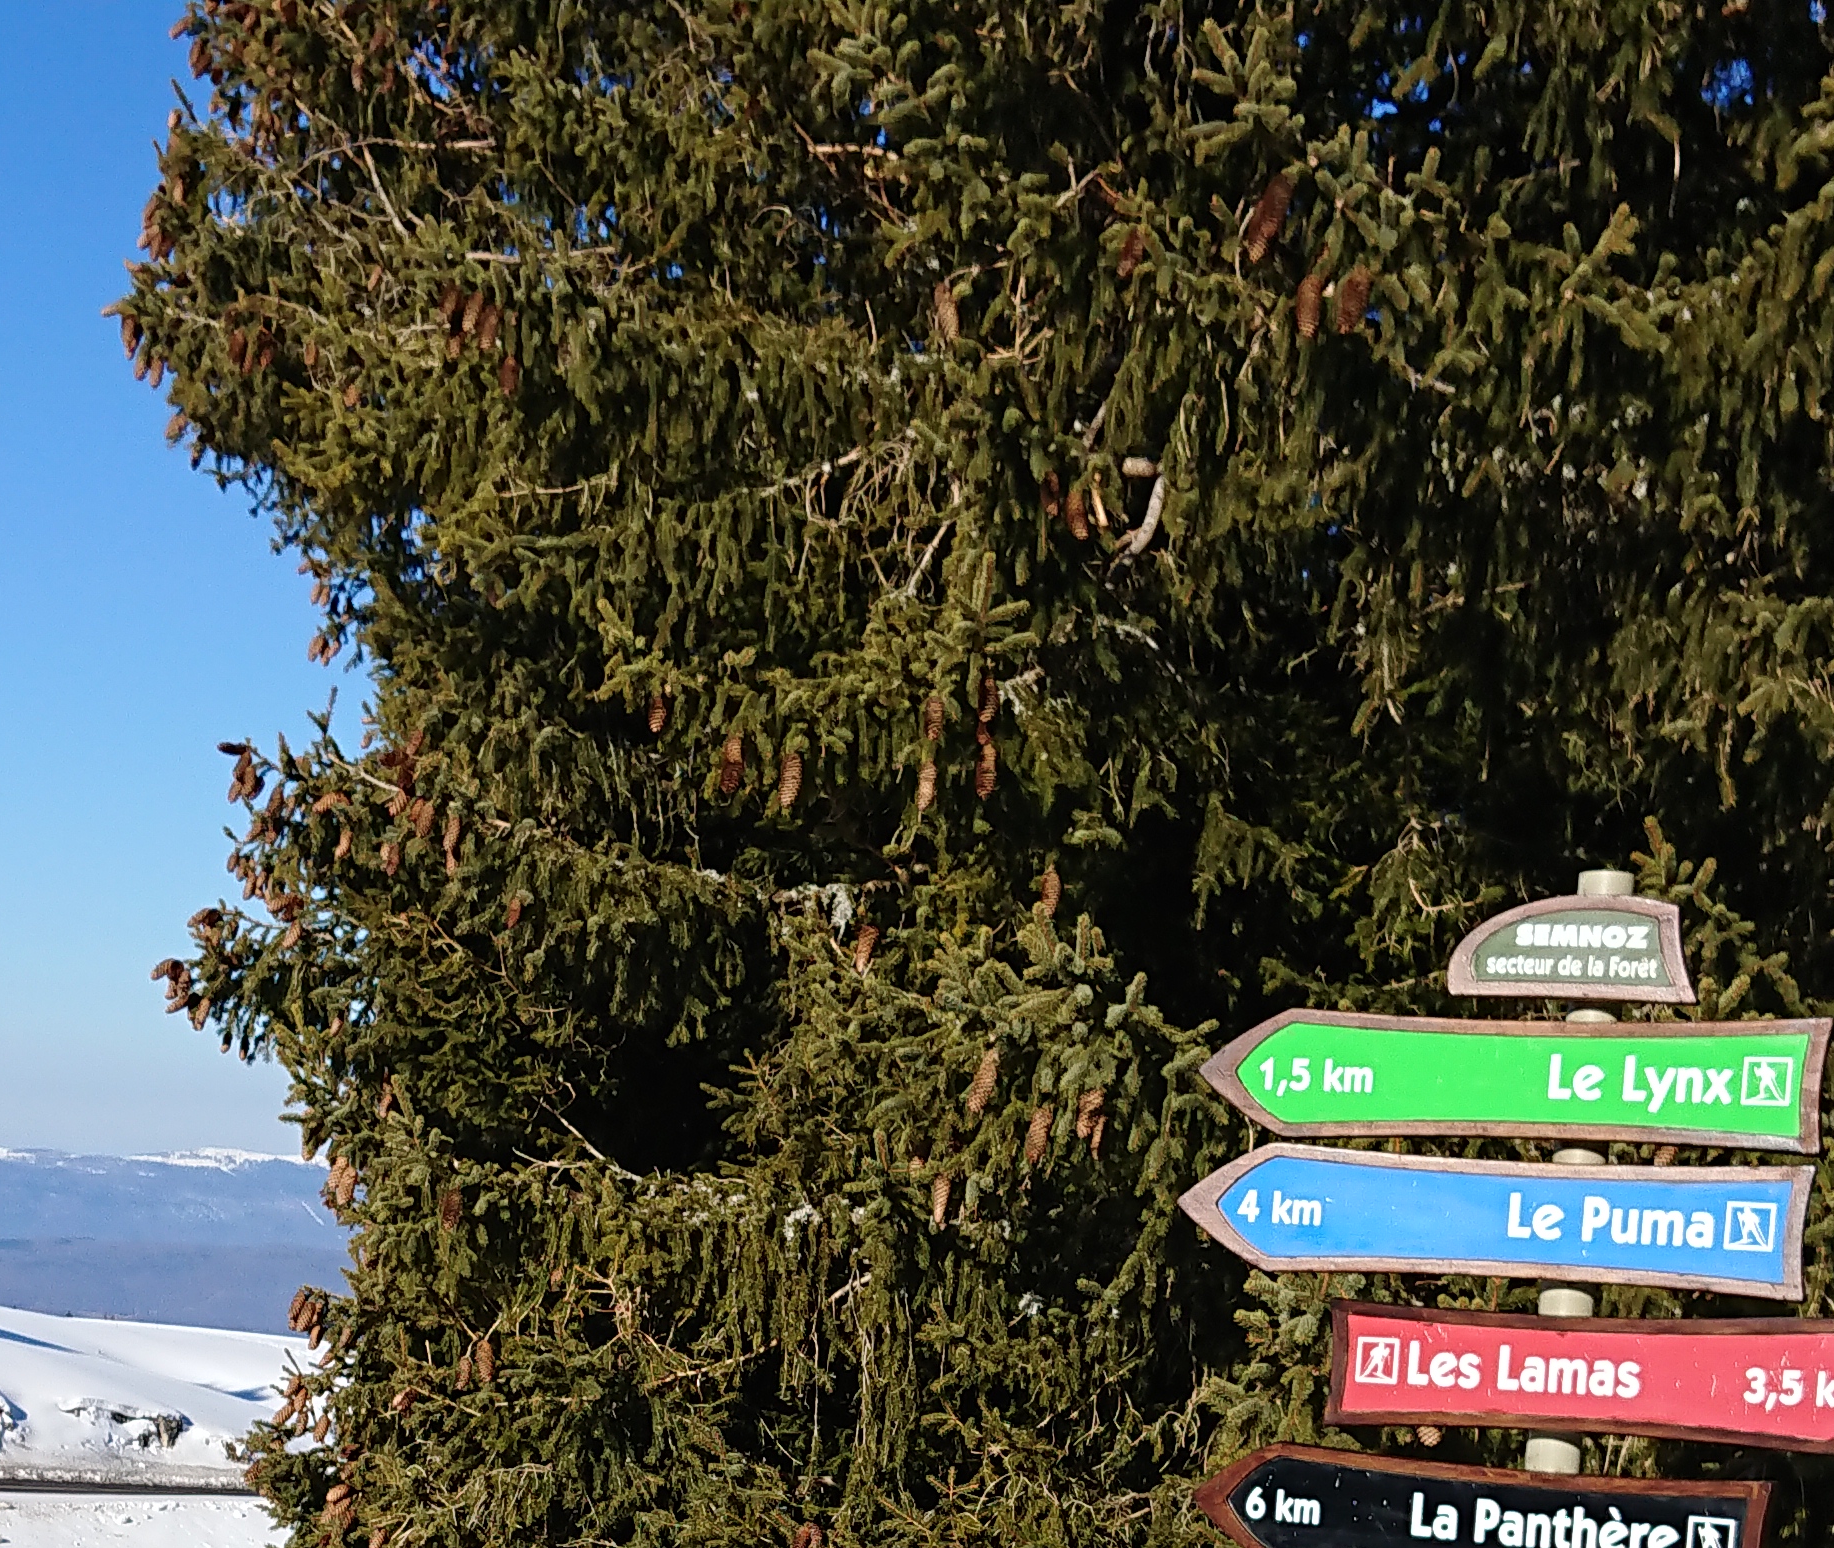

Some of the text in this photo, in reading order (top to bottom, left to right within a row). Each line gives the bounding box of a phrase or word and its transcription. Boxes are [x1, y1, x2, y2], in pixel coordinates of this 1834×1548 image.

[1515, 923, 1649, 949] SEMNOZ
[1486, 955, 1555, 976] secteur
[1558, 955, 1581, 977] de
[1588, 956, 1604, 978] la
[1259, 1058, 1374, 1097] 1,5 km
[1548, 1054, 1734, 1113] Le Lynx
[1237, 1190, 1323, 1227] 4 km
[1508, 1192, 1714, 1249] Le Puma
[1407, 1341, 1642, 1399] Les Lamas
[1743, 1368, 1803, 1412] 3,5
[1246, 1487, 1321, 1526] 6 km
[1410, 1492, 1458, 1541] La
